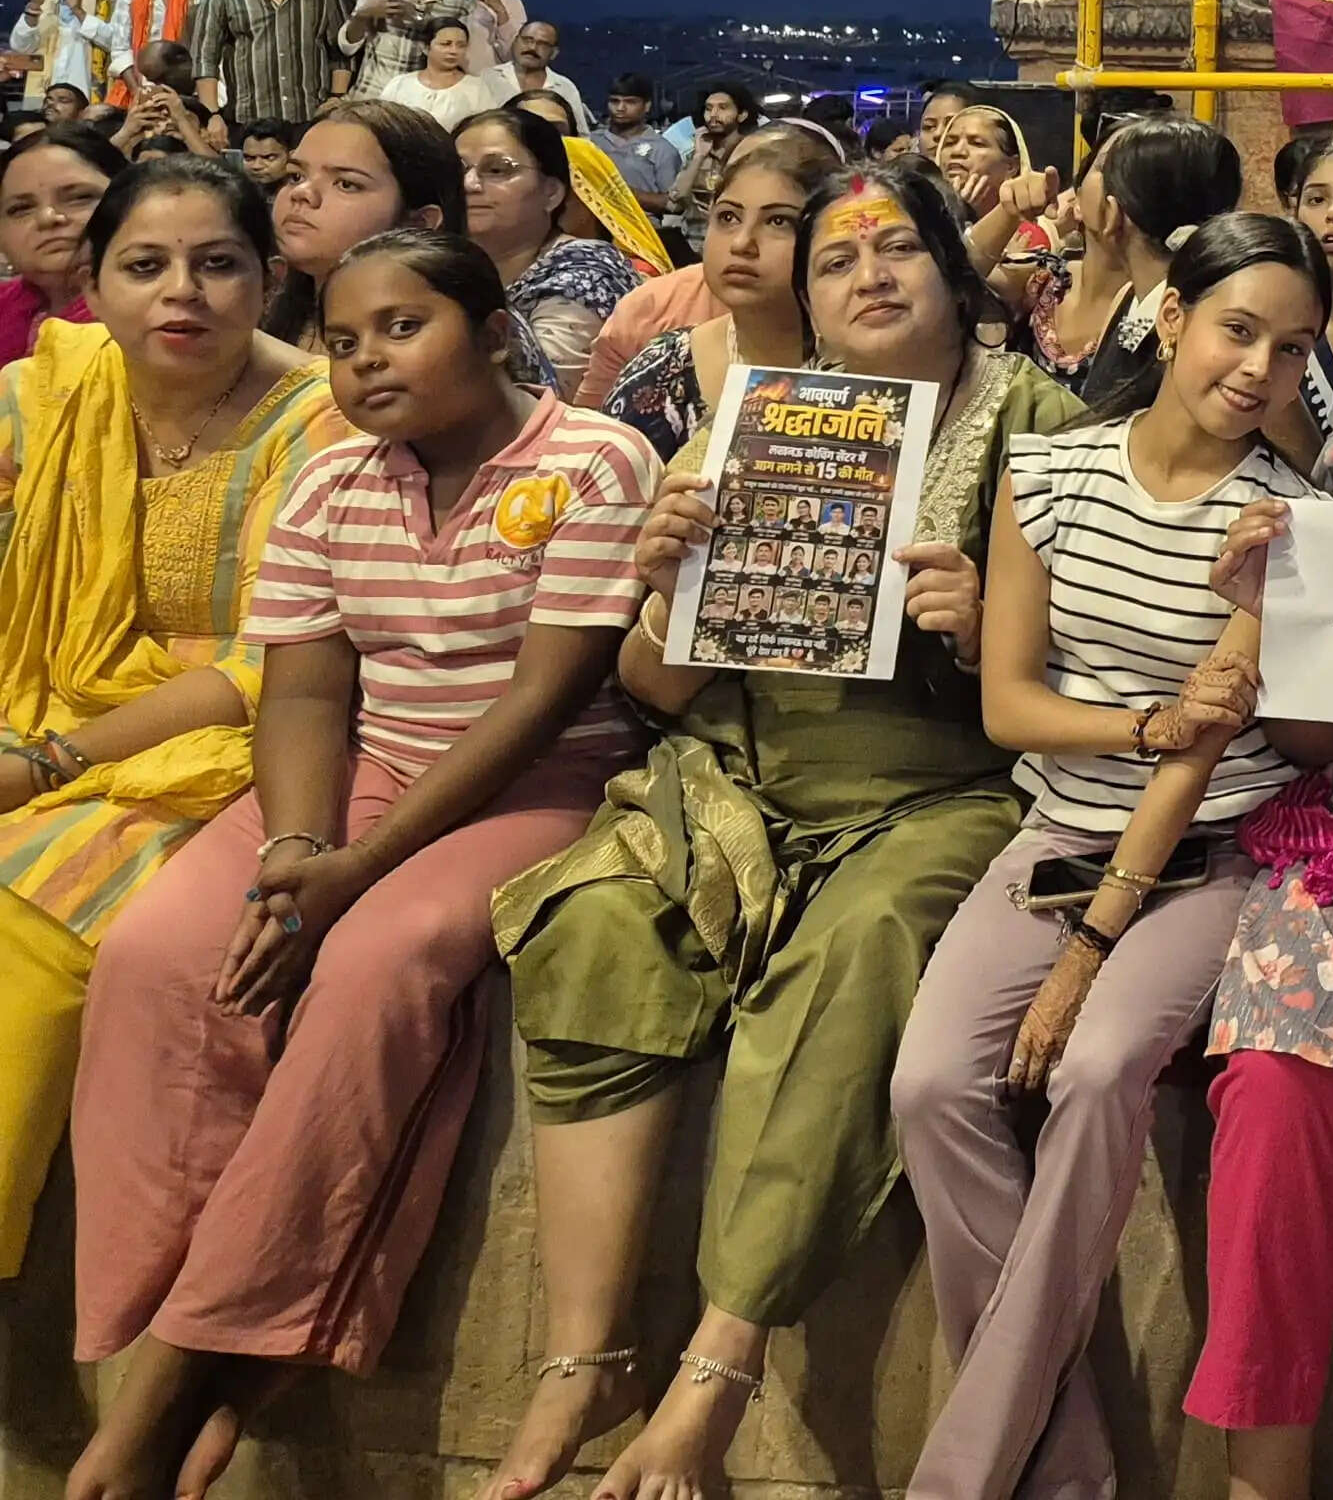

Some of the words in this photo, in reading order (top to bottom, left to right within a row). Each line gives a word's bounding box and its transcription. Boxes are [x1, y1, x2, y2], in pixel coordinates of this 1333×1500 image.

[798, 385, 851, 408] भावपूर्ण
[762, 402, 888, 442] श्रद्धांजलि
[753, 460, 775, 472] आग
[777, 460, 803, 475] लगने
[804, 463, 815, 475] से
[816, 462, 837, 479] 15
[838, 465, 853, 480] की
